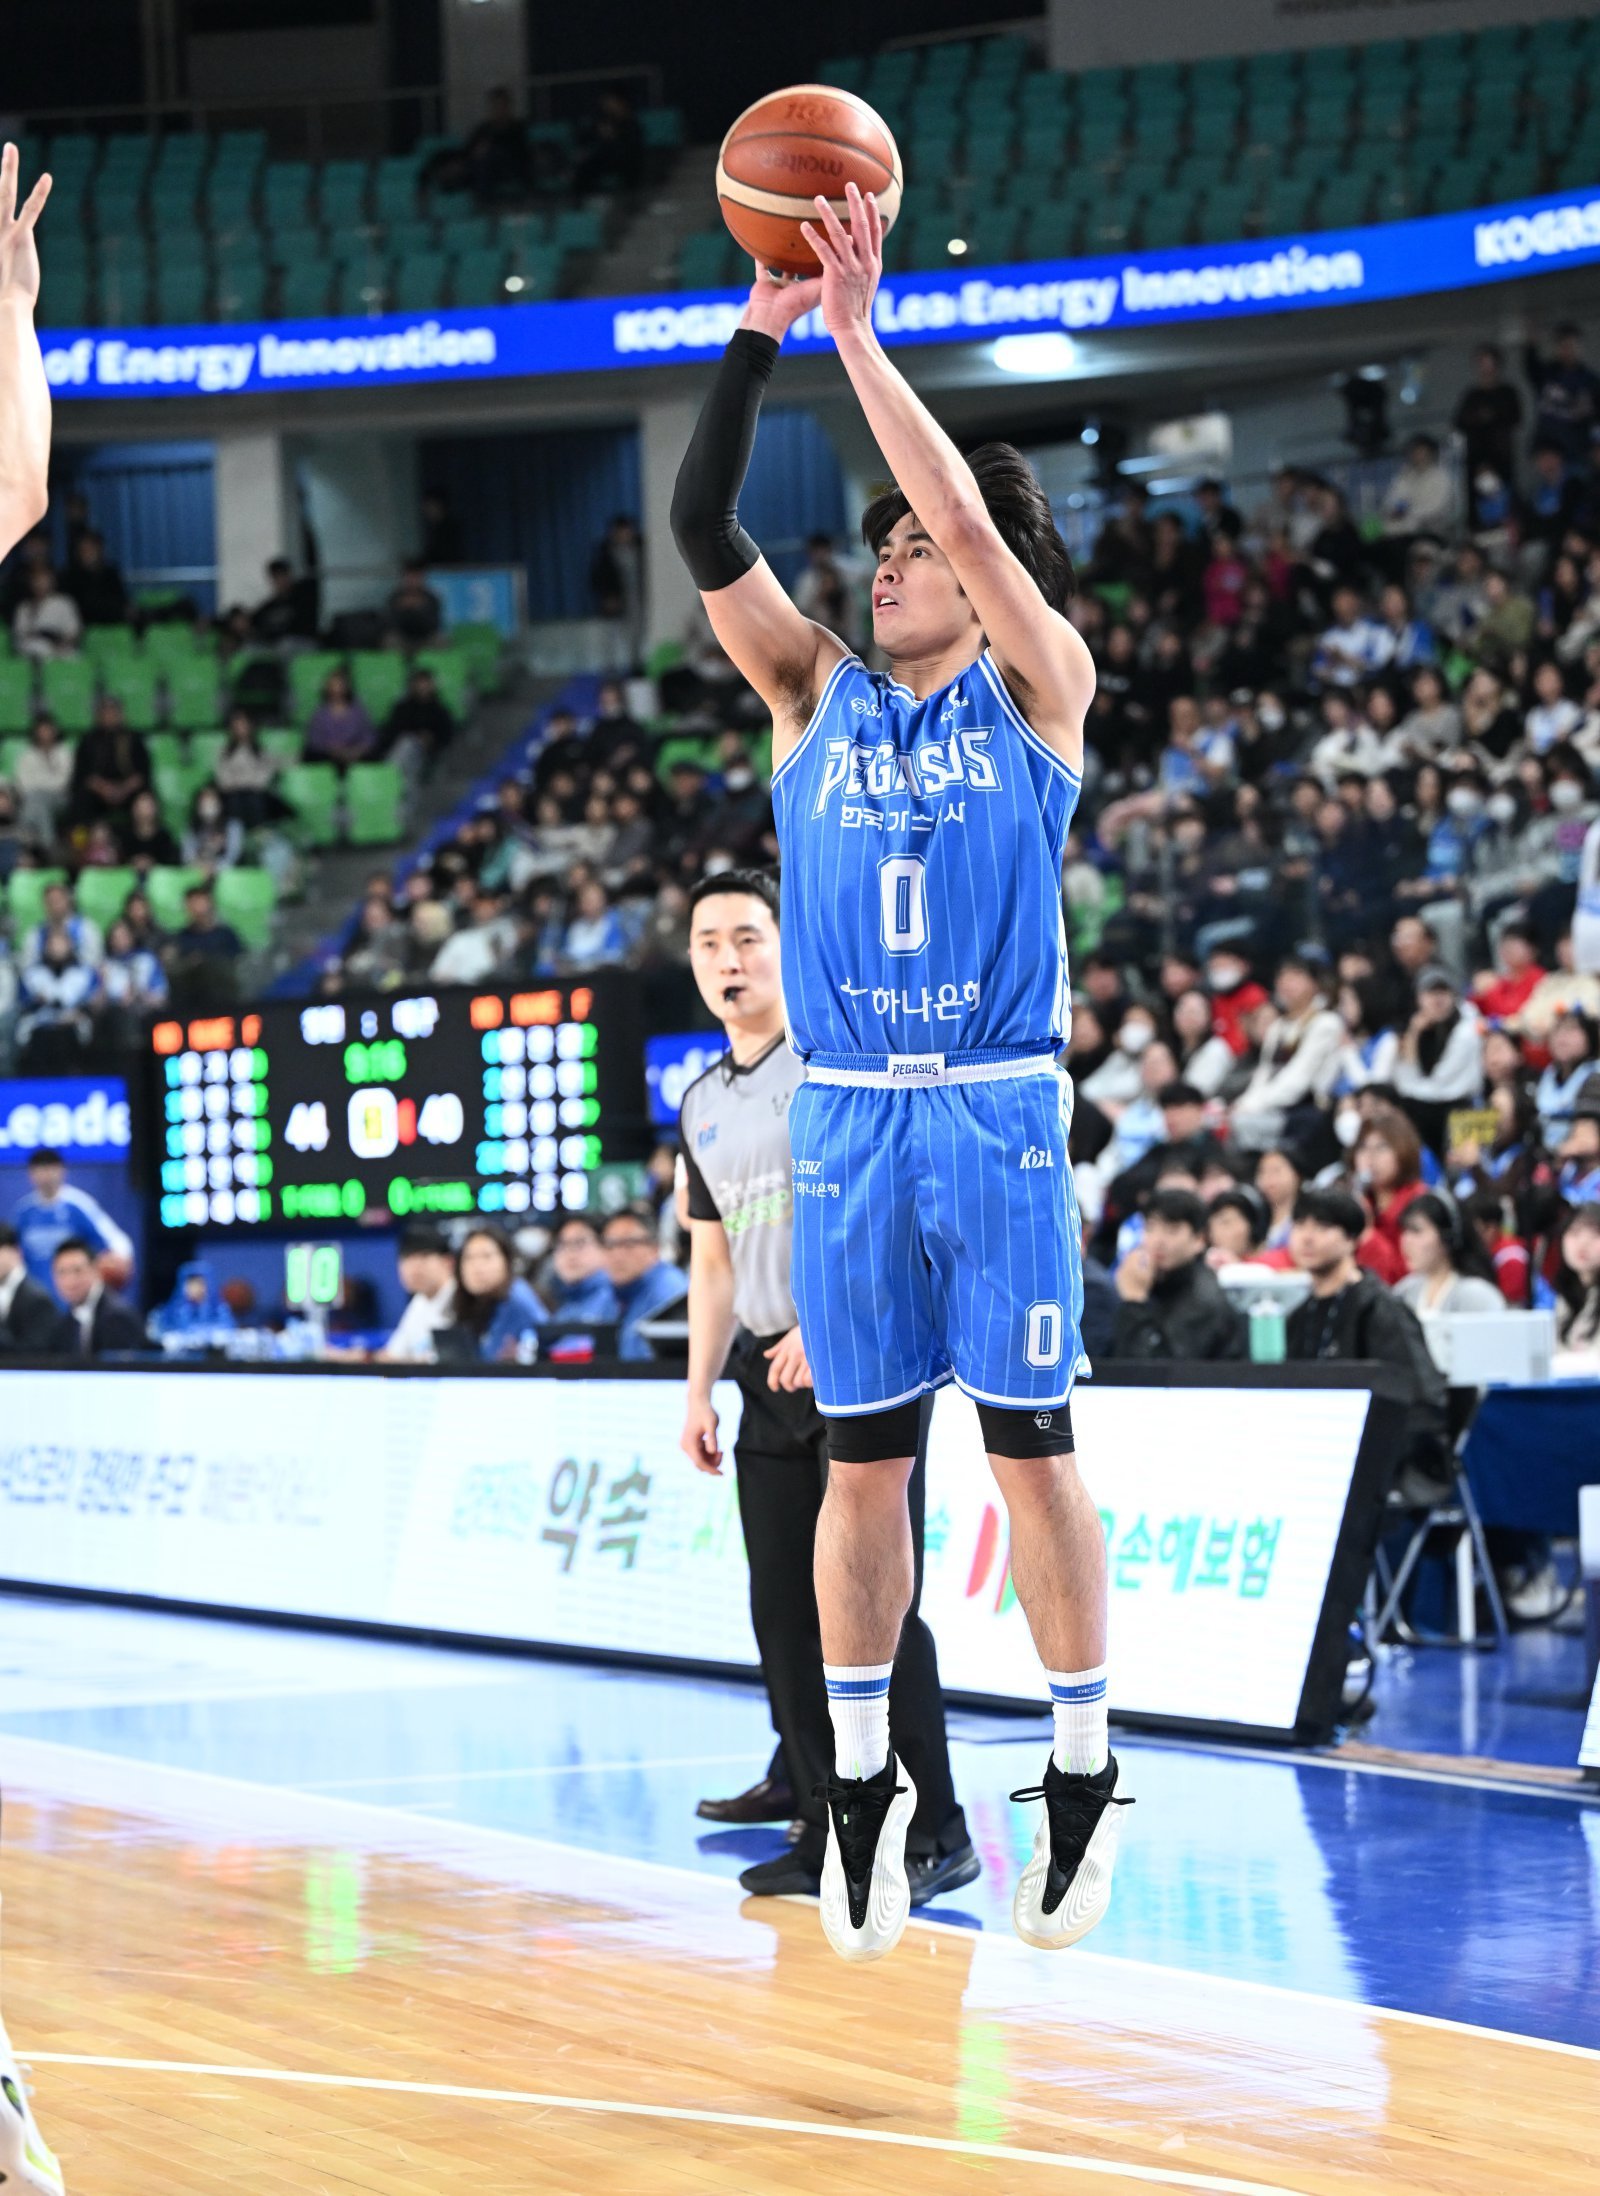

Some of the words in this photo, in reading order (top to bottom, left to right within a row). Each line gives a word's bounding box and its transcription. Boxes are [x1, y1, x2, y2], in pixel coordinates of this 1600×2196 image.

[613, 303, 748, 353] KOGA
[1122, 245, 1364, 312] Innovation
[43, 338, 95, 386] of
[96, 340, 256, 392] Energy
[258, 320, 498, 379] Innovation
[812, 726, 1003, 820] PEGASUS
[877, 853, 931, 957] 0
[892, 1062, 939, 1078] PEGASUS
[796, 1181, 840, 1198] 하나은행
[797, 1160, 822, 1175] STIZ
[1023, 1299, 1063, 1370] 0
[541, 1455, 652, 1573] 약속
